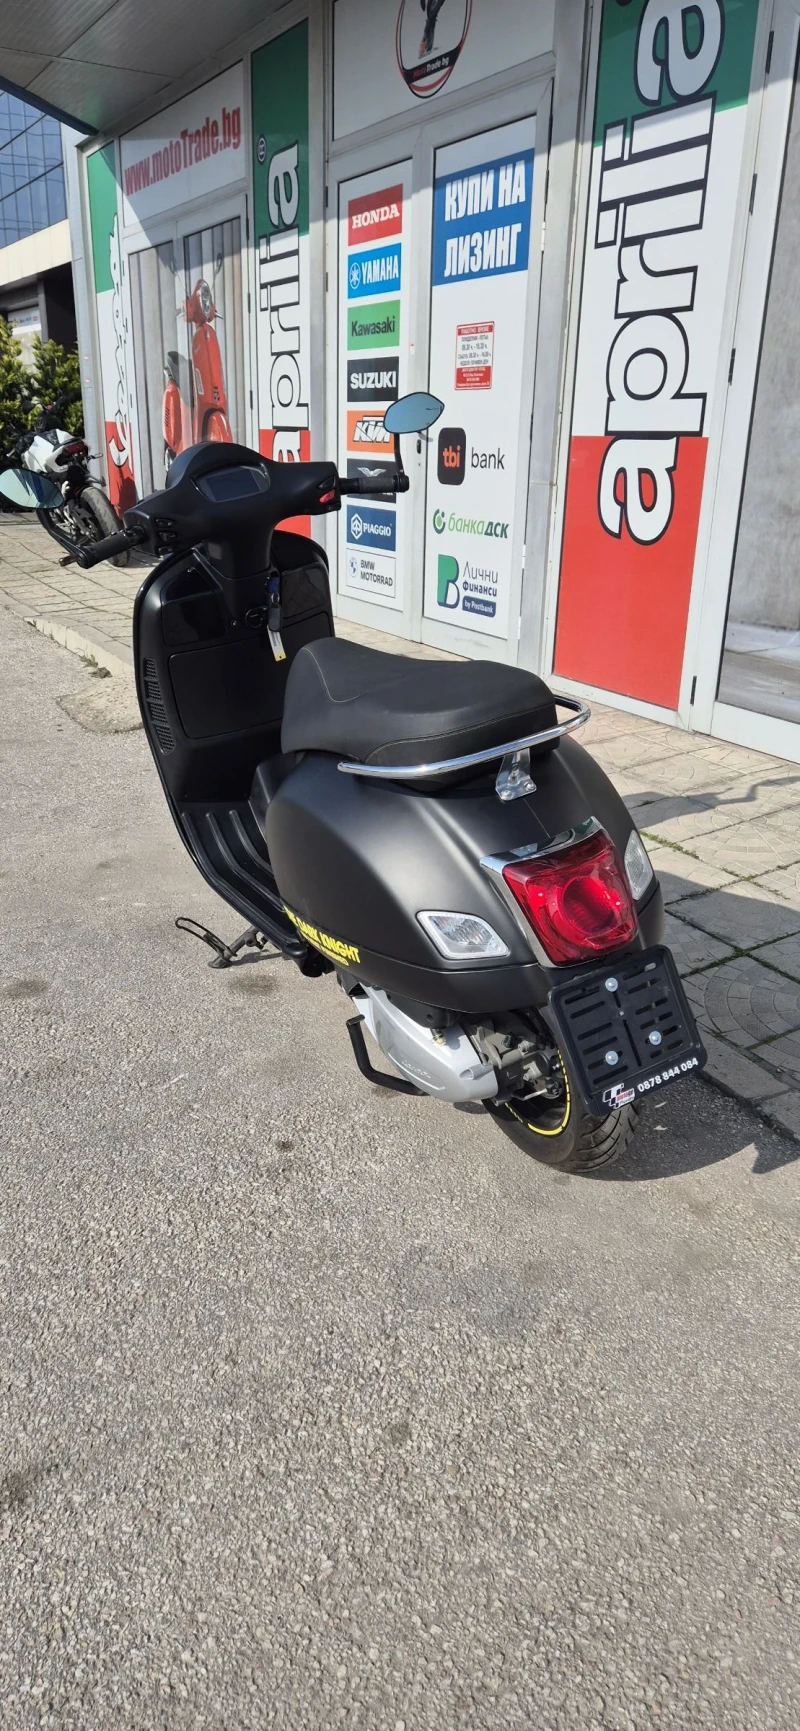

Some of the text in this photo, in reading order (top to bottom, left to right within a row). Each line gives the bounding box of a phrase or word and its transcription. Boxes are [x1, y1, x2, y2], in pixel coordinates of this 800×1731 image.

[125, 107, 241, 196] www.motoTrade.bg
[445, 160, 526, 222] КУПИ НА
[352, 204, 400, 229] HONDA
[444, 222, 522, 278] ЛИЗИНГ
[361, 255, 399, 285] YAMAHA
[595, 0, 724, 546] aprilia
[351, 316, 395, 337] Kawasaki
[350, 371, 397, 389] SUZUKI
[353, 415, 391, 443] KTM
[443, 445, 505, 470] tbi bank
[363, 522, 392, 537] PIAGGIO
[360, 559, 375, 571] BMW
[463, 561, 498, 584] Лични
[360, 571, 393, 587] MOTORRAD
[462, 580, 498, 597] Финанси
[464, 599, 494, 613] by Postbank
[319, 931, 361, 964] KNIGHT
[637, 1057, 699, 1093] 0878 844 084
